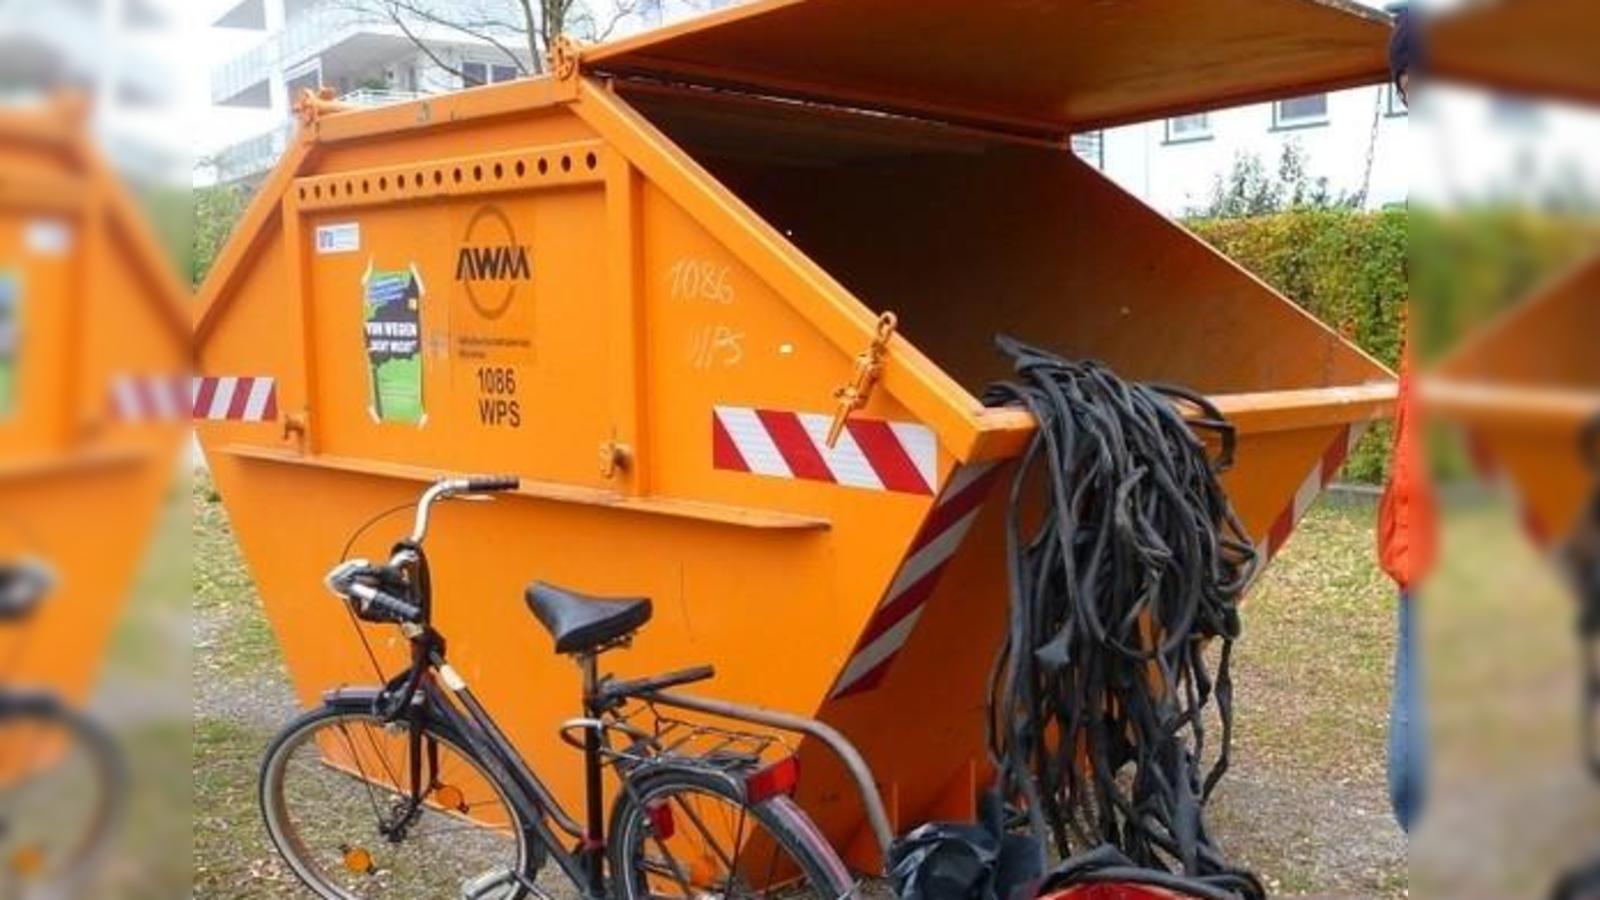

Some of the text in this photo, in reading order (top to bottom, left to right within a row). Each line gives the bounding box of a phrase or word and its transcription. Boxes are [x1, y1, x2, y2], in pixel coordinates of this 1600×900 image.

[456, 246, 530, 280] AWM
[665, 258, 734, 304] 1086
[477, 368, 516, 394] 1086
[479, 400, 521, 427] WPS
